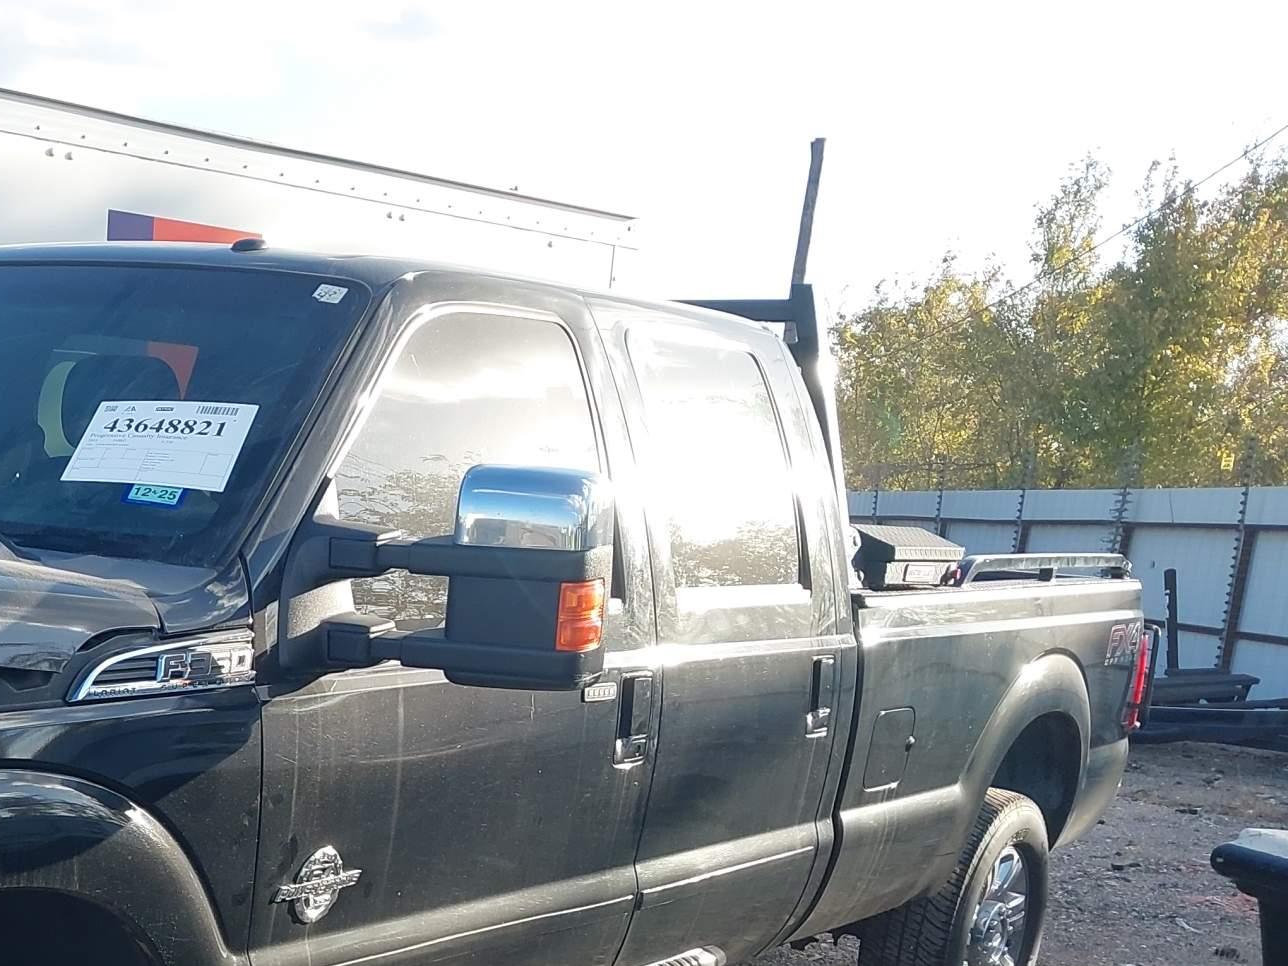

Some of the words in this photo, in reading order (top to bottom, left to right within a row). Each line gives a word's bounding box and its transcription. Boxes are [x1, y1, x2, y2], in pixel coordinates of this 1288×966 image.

[103, 417, 227, 437] 43648821
[134, 486, 152, 497] 12
[157, 489, 179, 501] 25
[1106, 621, 1141, 658] FX4
